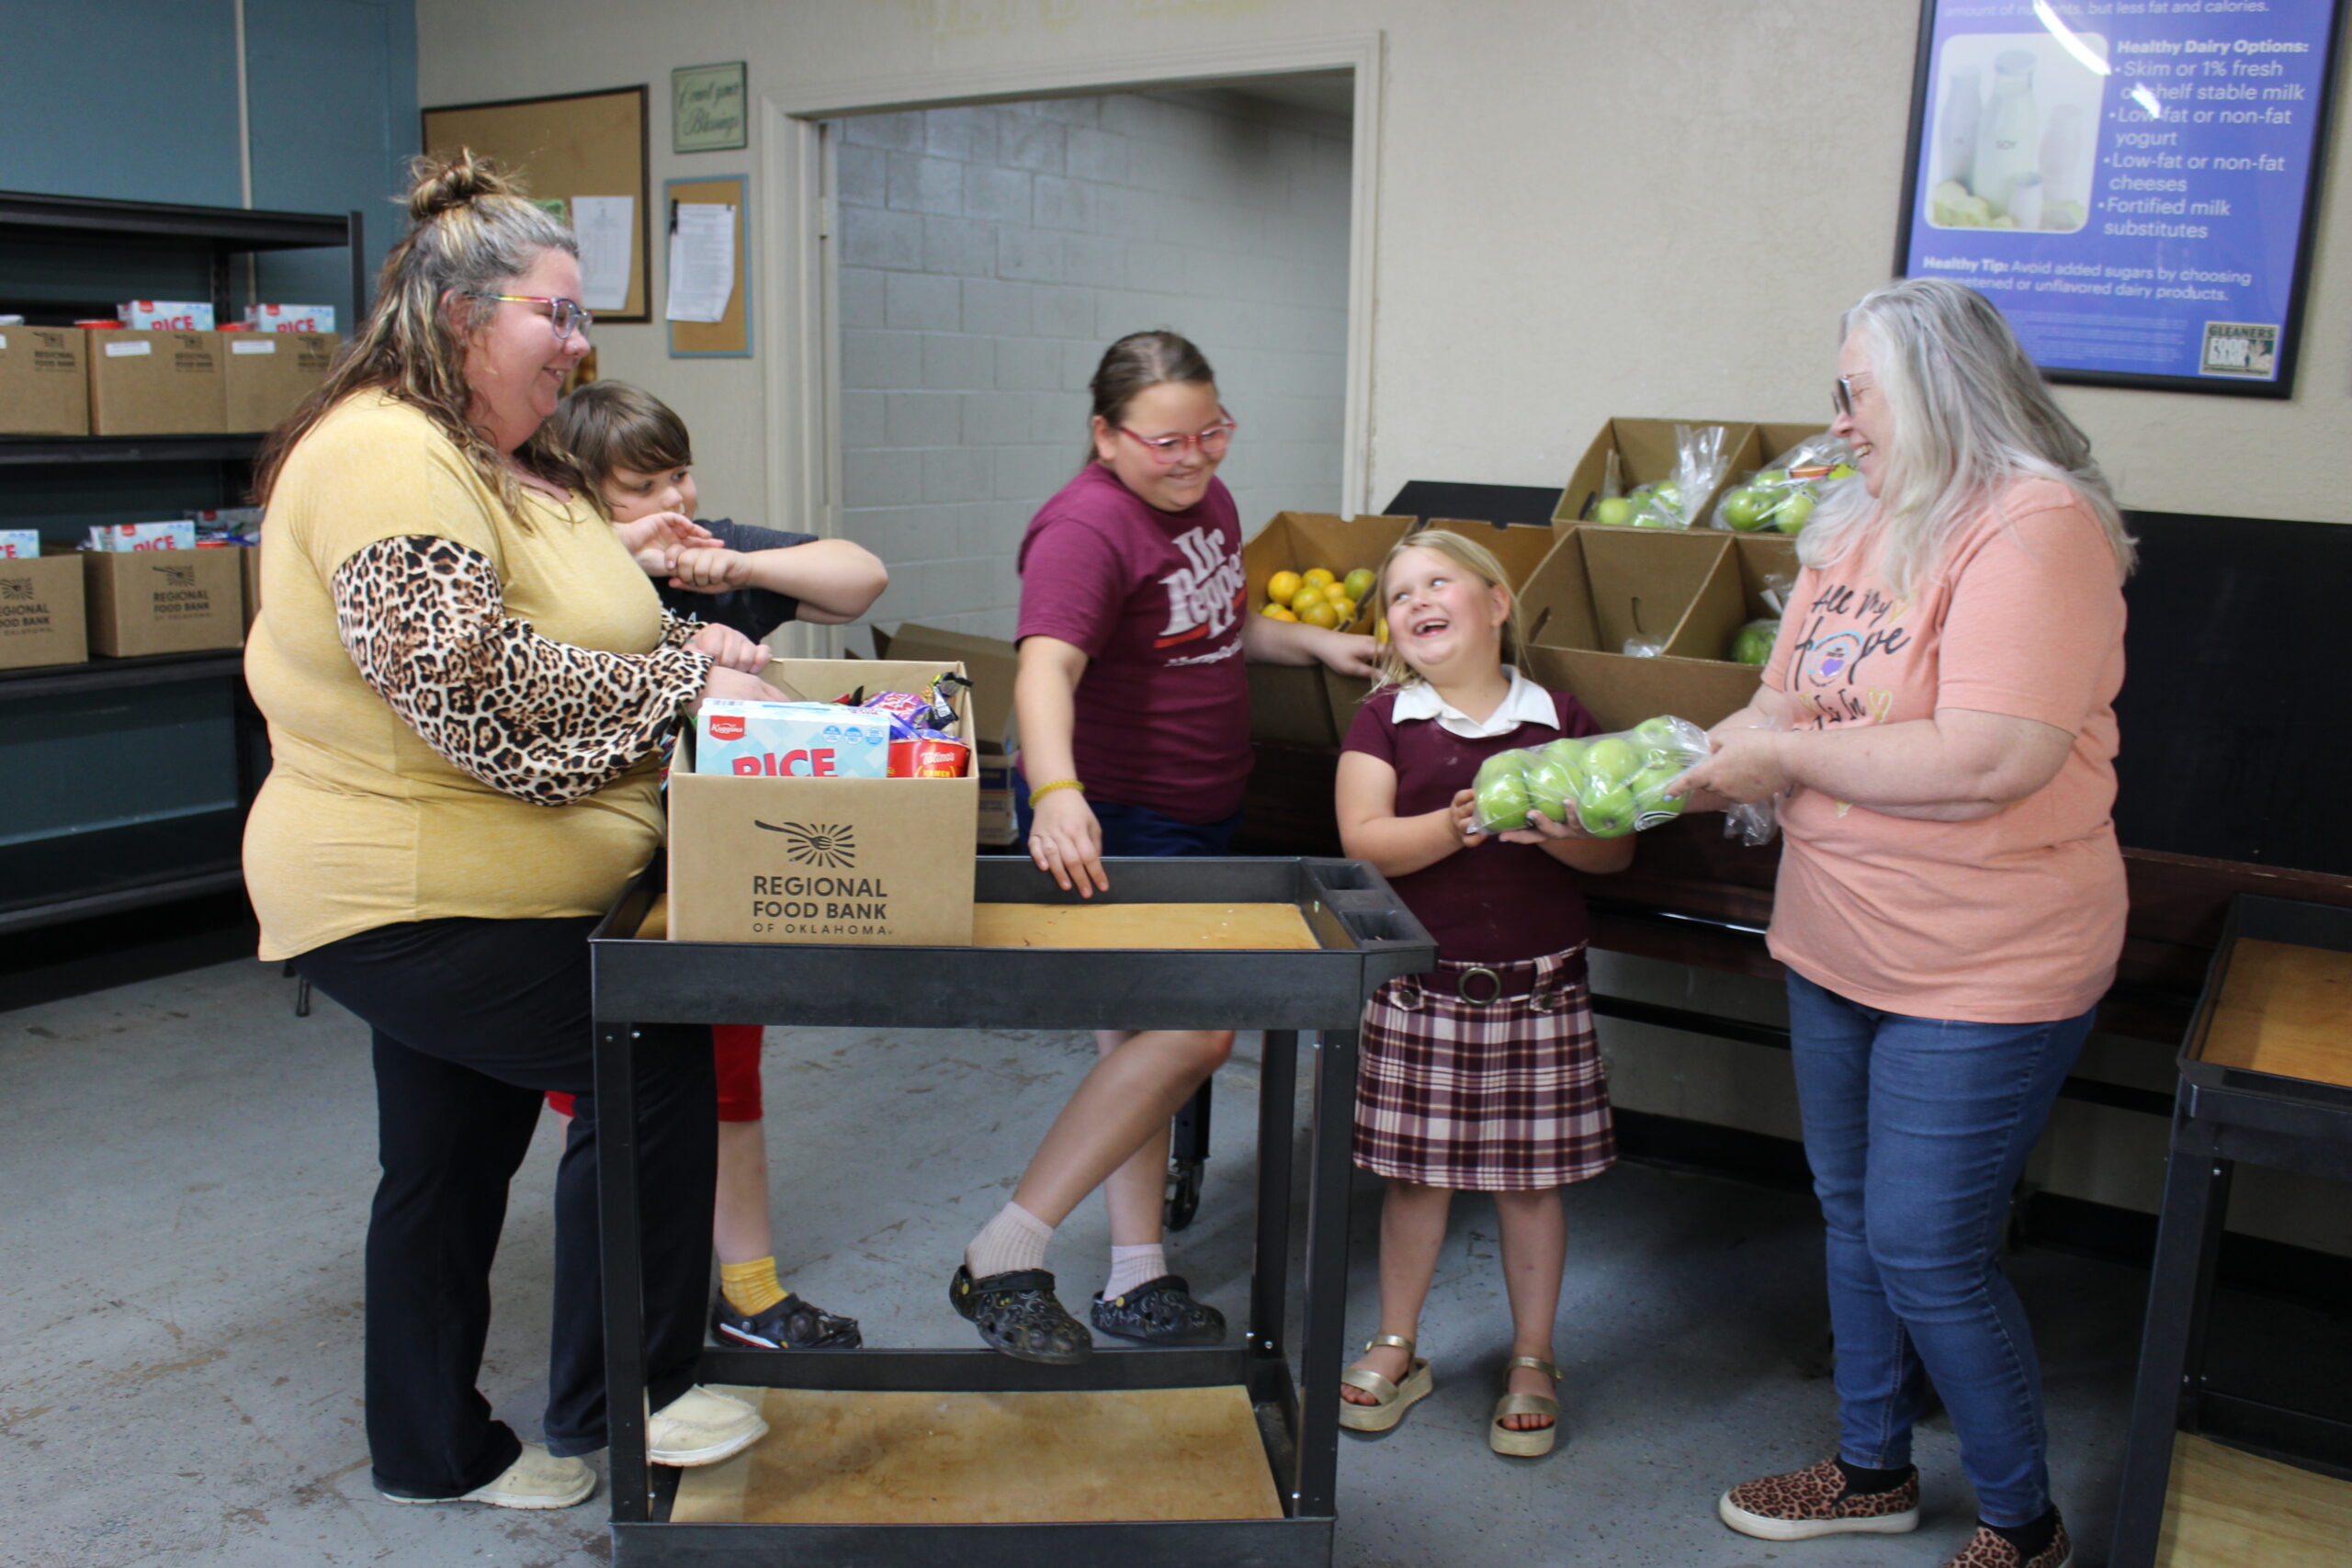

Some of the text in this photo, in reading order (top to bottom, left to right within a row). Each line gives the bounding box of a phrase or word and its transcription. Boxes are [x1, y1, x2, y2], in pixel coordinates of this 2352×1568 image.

[1998, 3, 2014, 15] of
[2087, 2, 2113, 15] but
[2116, 1, 2146, 14] less
[2148, 0, 2169, 14] fat
[2171, 0, 2202, 13] and
[2204, 0, 2270, 13] calories.
[2117, 39, 2309, 56] Healthy Dairy Options:
[2123, 60, 2283, 77] Skim or 1% fresh
[2197, 84, 2258, 101] stable
[2264, 85, 2305, 101] milk
[2117, 107, 2292, 126] Low-fat or non-fat
[2115, 130, 2178, 148] yogurt
[2112, 152, 2285, 172] Low-fat or non-fat
[2109, 175, 2188, 193] cheeses
[2106, 198, 2232, 217] Fortified milk
[2104, 221, 2209, 239] substitutes
[1923, 256, 2252, 287] Healthy Tip: Avoid added sugars by choosing
[2016, 279, 2032, 291] or
[2034, 278, 2111, 297] unflavored
[2115, 282, 2152, 300] dairy
[2155, 285, 2229, 302] products.
[2208, 325, 2275, 338] GLEANERS
[1811, 584, 1893, 628] All My
[731, 748, 839, 777] RICE
[752, 875, 888, 898] REGIONAL
[752, 900, 888, 919] FOOD BANK
[752, 922, 775, 933] OF
